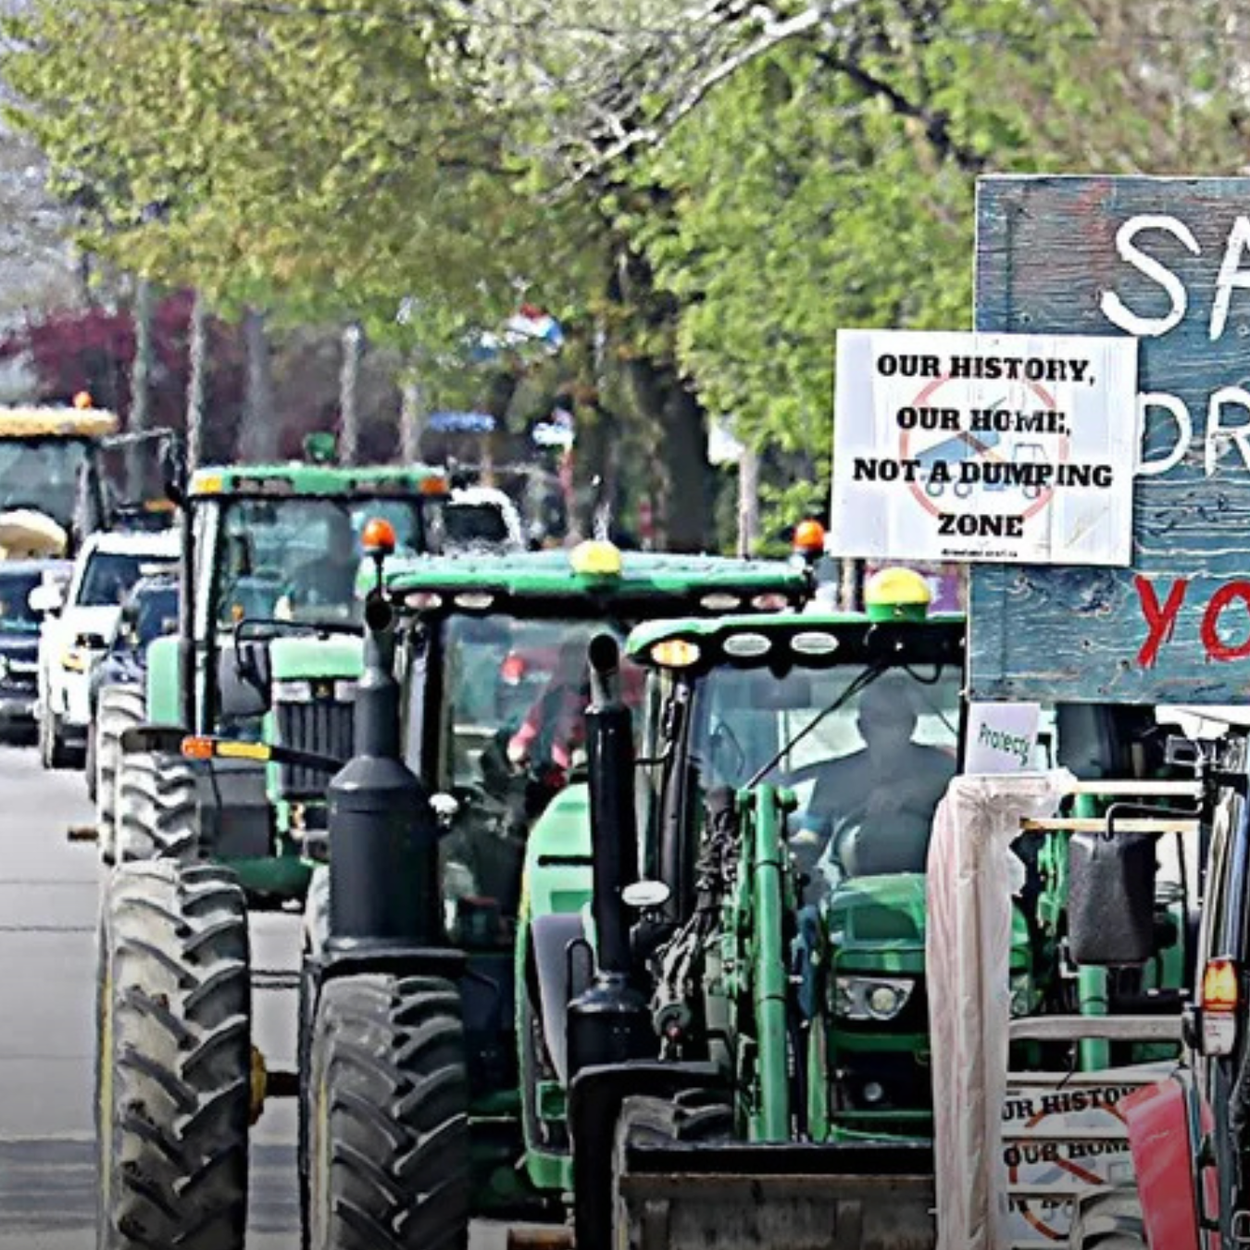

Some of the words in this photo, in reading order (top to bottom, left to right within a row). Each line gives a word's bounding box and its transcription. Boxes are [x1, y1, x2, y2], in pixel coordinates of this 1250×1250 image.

[877, 354, 939, 377] OUR
[950, 357, 1095, 385] HISTORY,
[897, 406, 960, 430] OUR
[970, 409, 1071, 435] HOME,
[853, 458, 920, 481] NOT
[929, 463, 952, 484] A
[960, 462, 1112, 488] DUMPING
[938, 514, 1024, 537] ZONE
[1000, 1100, 1034, 1121] UR
